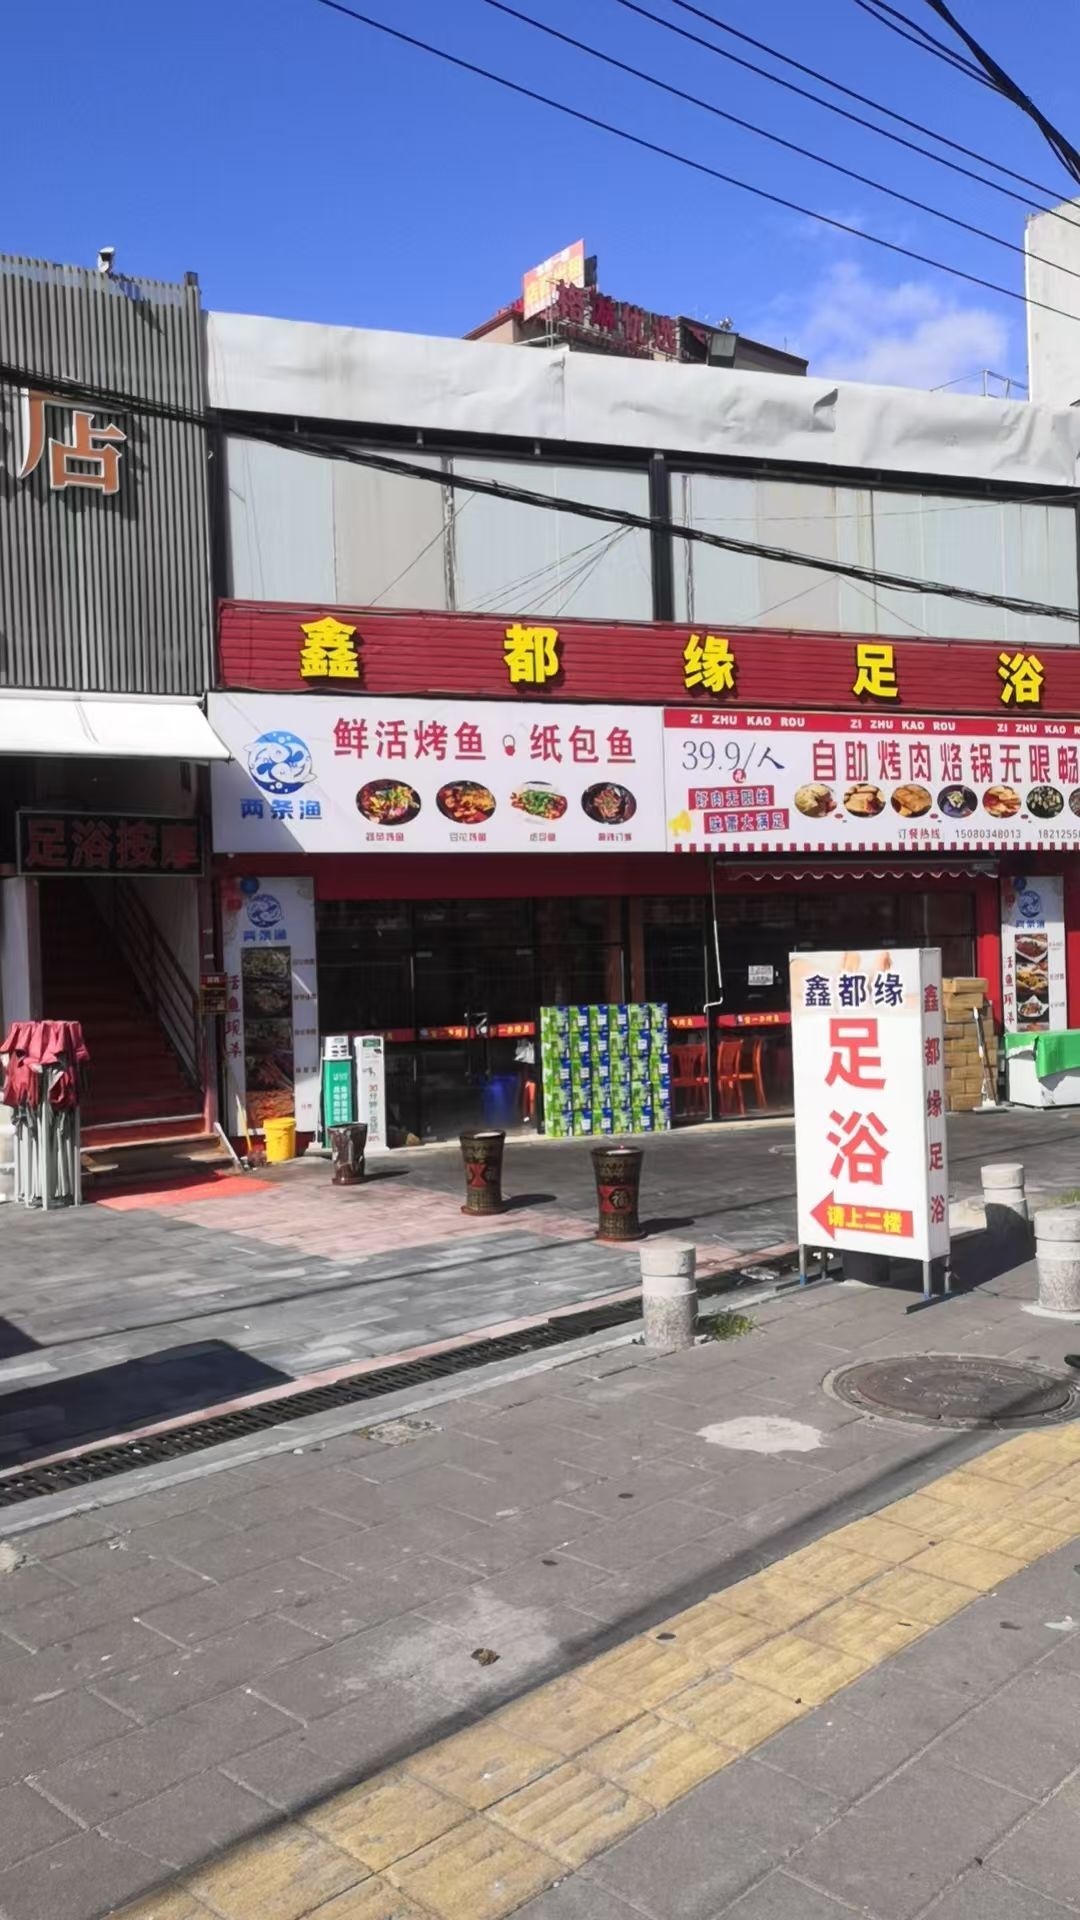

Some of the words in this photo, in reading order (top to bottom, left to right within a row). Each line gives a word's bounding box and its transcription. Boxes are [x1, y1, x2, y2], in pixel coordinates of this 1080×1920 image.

[300, 616, 1044, 703] 鑫都缘足浴
[690, 714, 703, 724] ZI
[712, 715, 737, 725] ZHU
[747, 716, 772, 726] KAO
[780, 717, 805, 727] ROU
[850, 719, 862, 729] ZI
[870, 720, 893, 729] ZHU
[902, 721, 925, 730] KAO
[933, 722, 956, 731] ROU
[997, 723, 1008, 733] ZI
[1016, 724, 1037, 734] ZHU
[1045, 725, 1066, 734] KAO
[333, 718, 486, 761] 鲜活烤鱼
[530, 723, 636, 763] 纸包鱼
[682, 740, 785, 772] 39.9/人
[241, 798, 322, 819] 两条渔
[898, 828, 941, 839] 订餐热线
[1038, 829, 1080, 839] 1821255
[805, 974, 904, 1008] 鑫都缘
[824, 1018, 890, 1185] 足浴
[923, 984, 946, 1224] 鑫都缘足浴
[827, 1205, 903, 1234] 请上二楼
